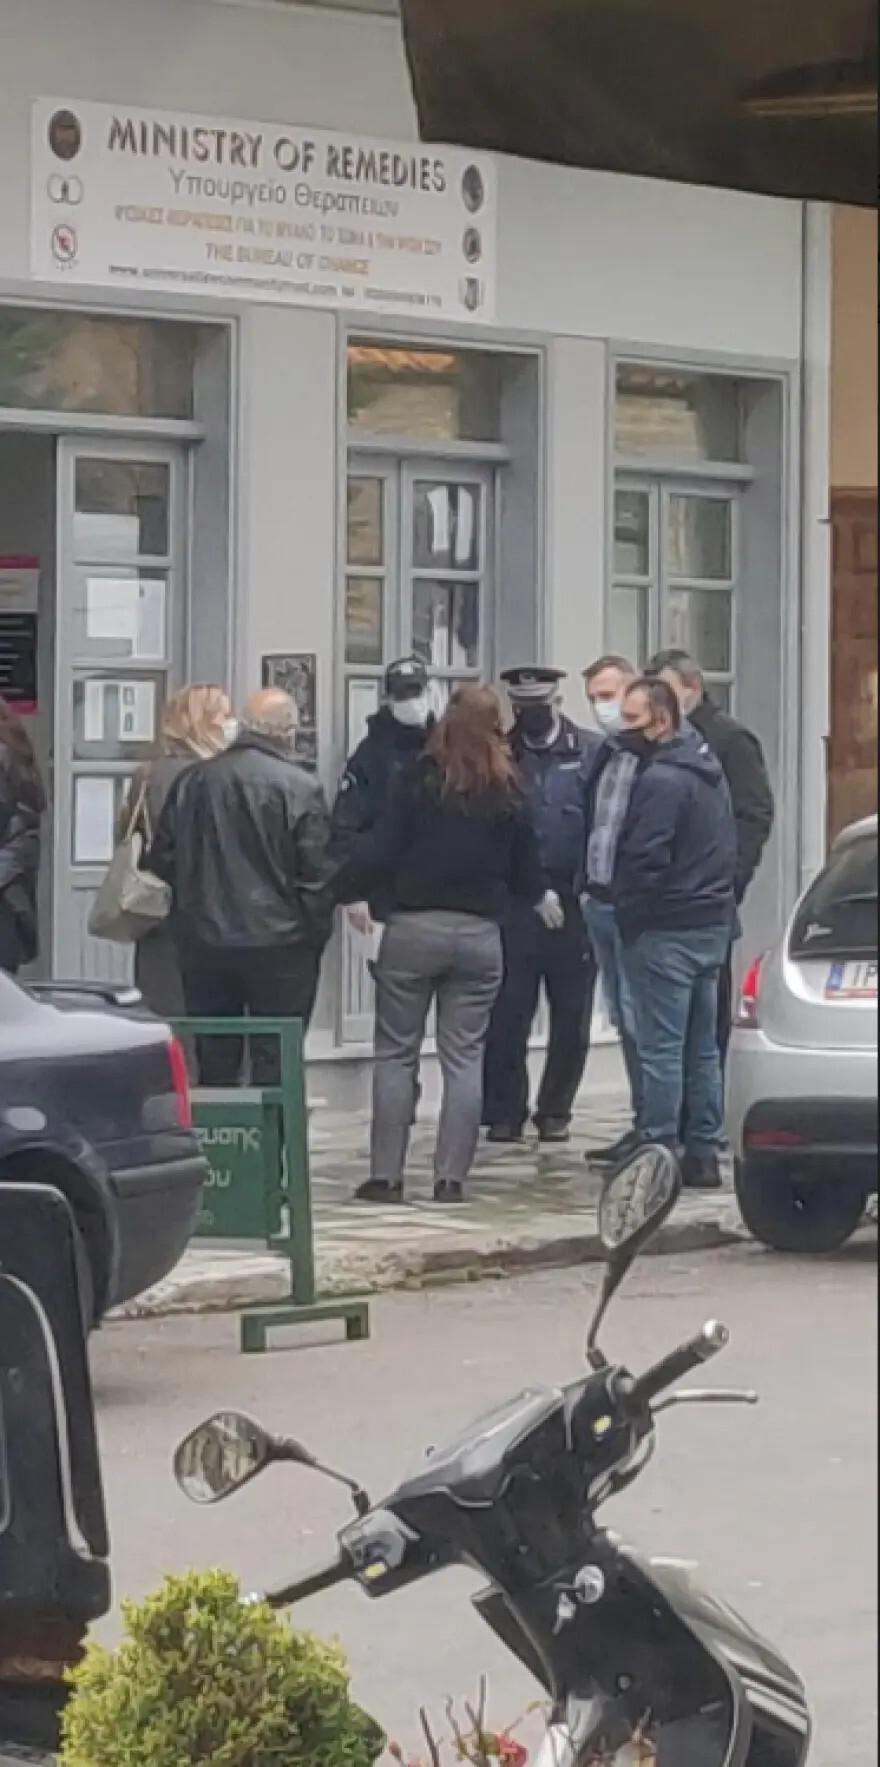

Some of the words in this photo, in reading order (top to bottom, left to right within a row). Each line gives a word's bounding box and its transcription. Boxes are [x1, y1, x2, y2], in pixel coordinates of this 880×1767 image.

[107, 116, 262, 168] MINISTRY
[274, 136, 315, 173] OF
[326, 144, 447, 192] REMEDIES
[169, 167, 286, 207] Υπουργείο
[205, 243, 233, 262] THE
[237, 245, 293, 267] BUREAU
